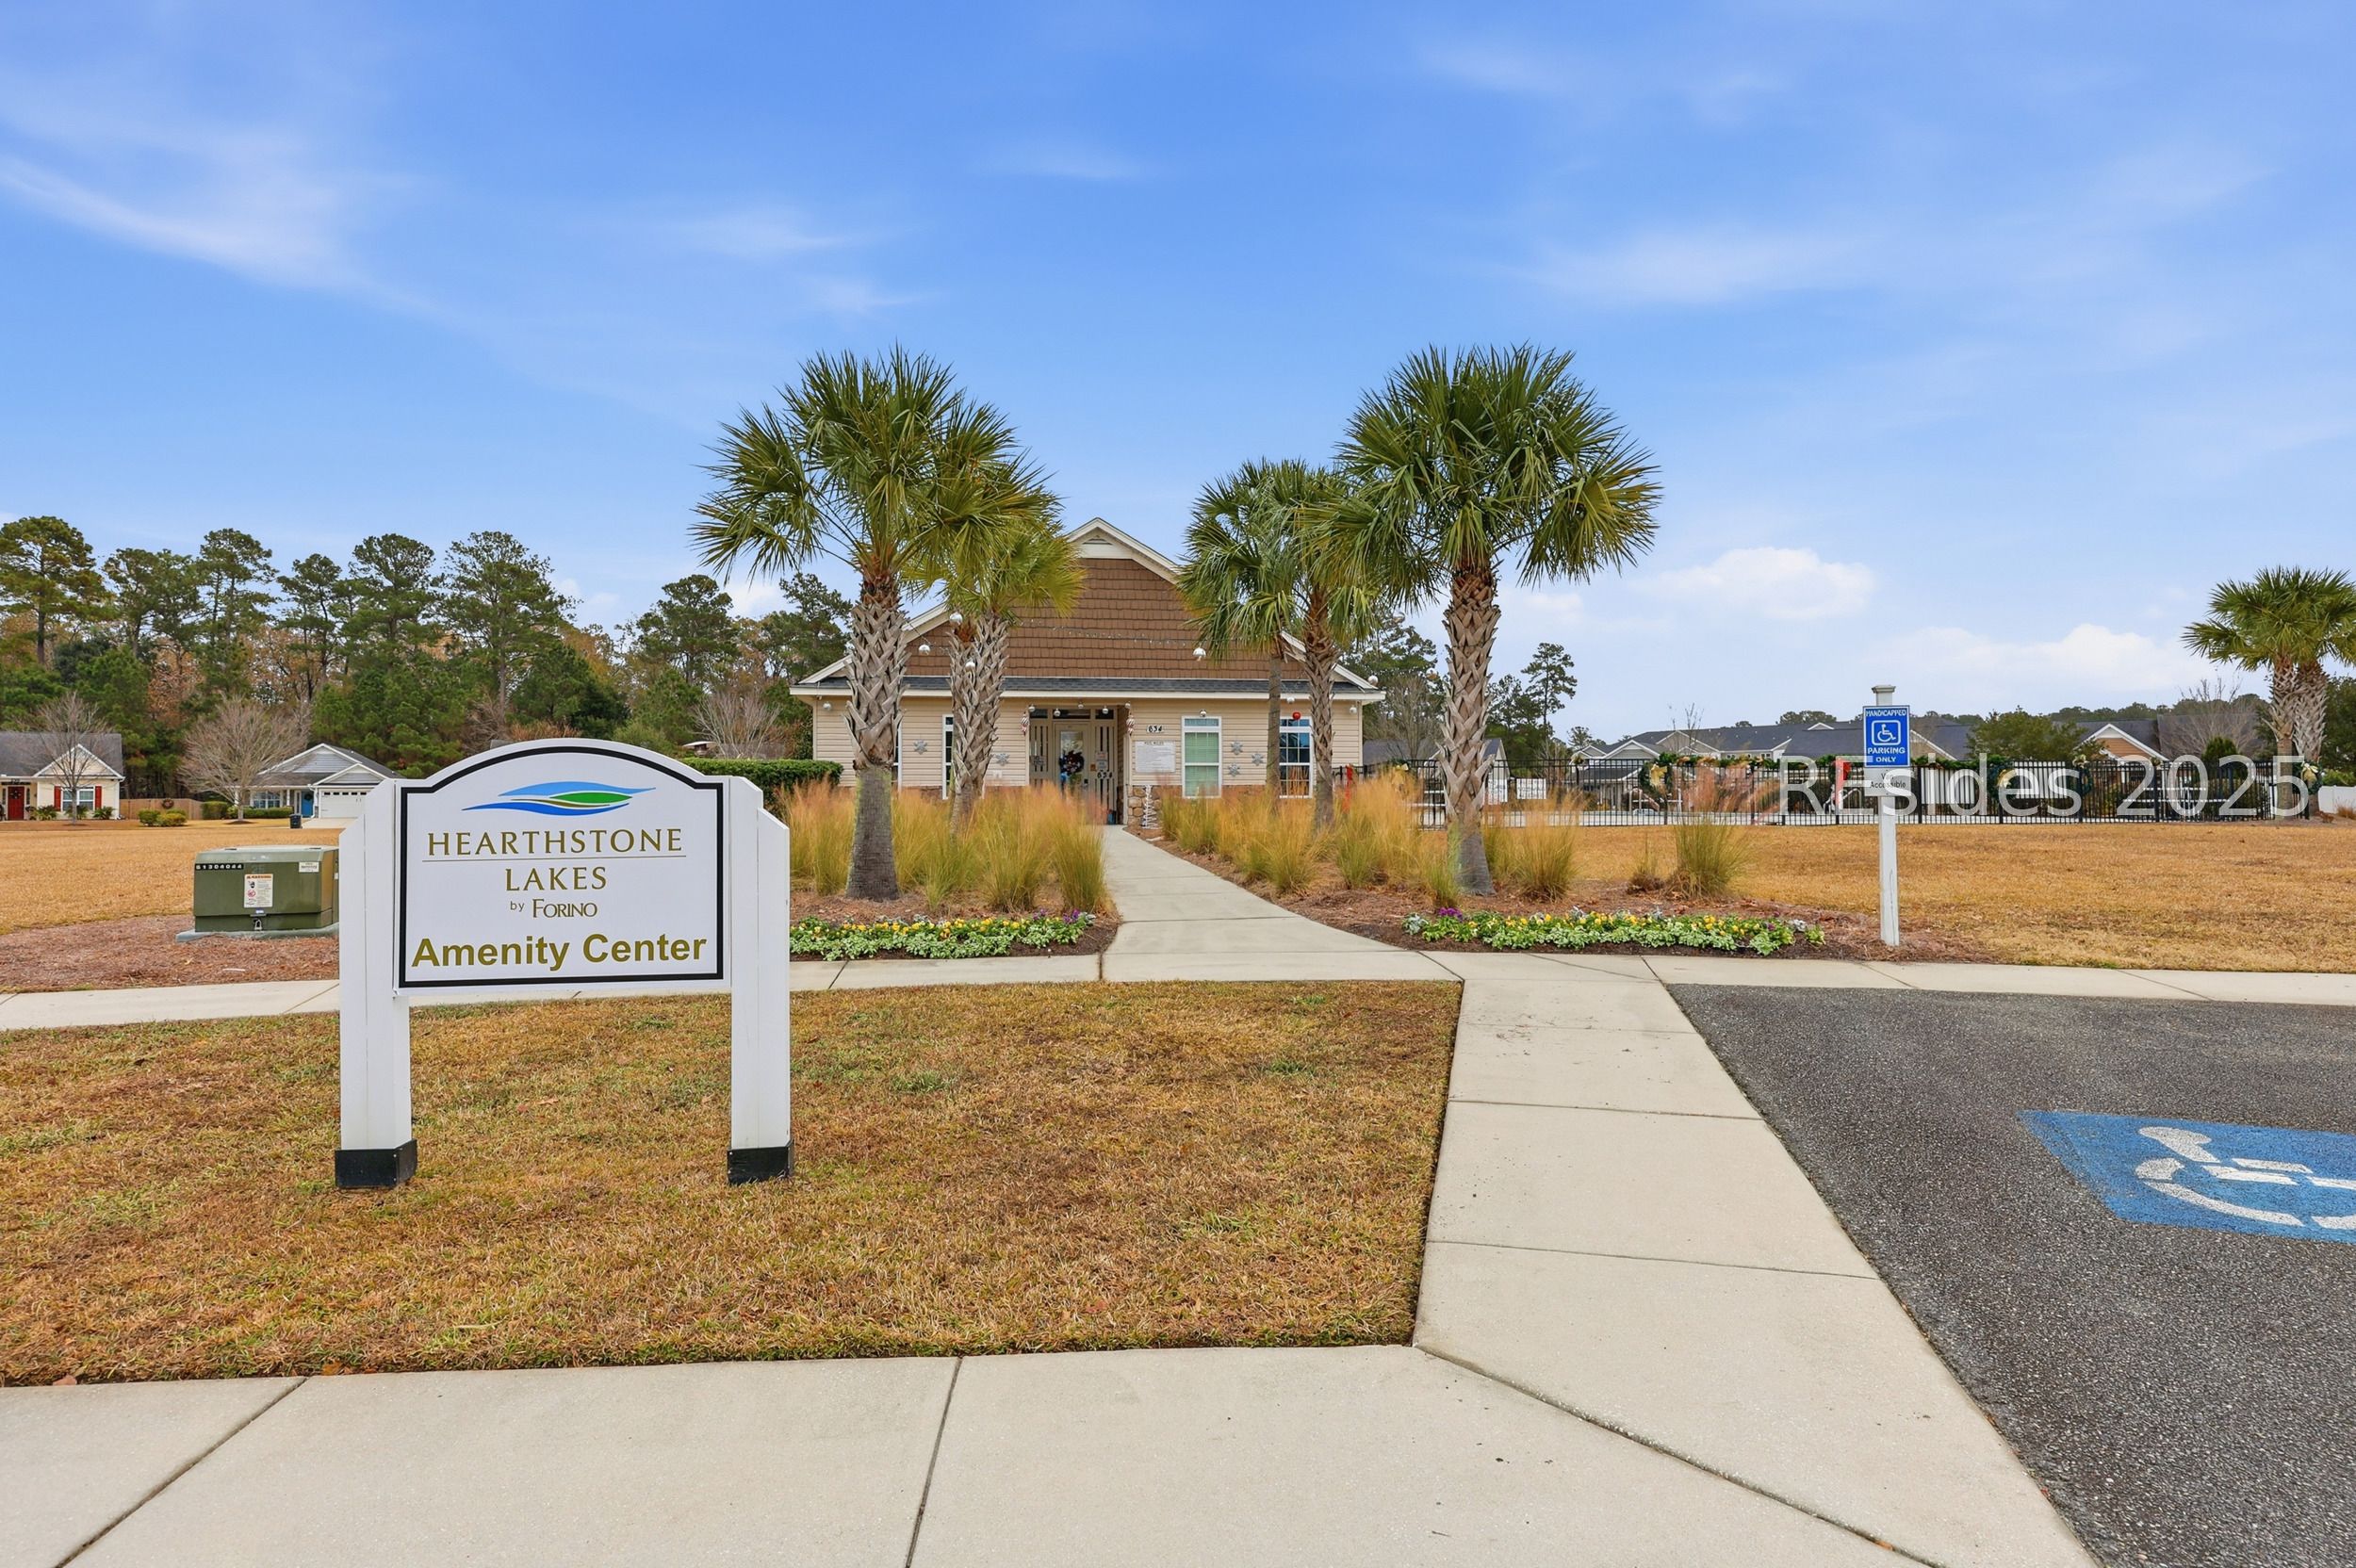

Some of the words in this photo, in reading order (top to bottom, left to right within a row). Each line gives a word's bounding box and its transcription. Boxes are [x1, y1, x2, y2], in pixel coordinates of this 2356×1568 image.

[428, 828, 682, 857] HEARTHSTONE
[505, 866, 607, 891] LAKES
[510, 900, 525, 912] by
[532, 898, 598, 919] FORINO
[411, 935, 571, 972] Amenity
[582, 933, 708, 963] Center
